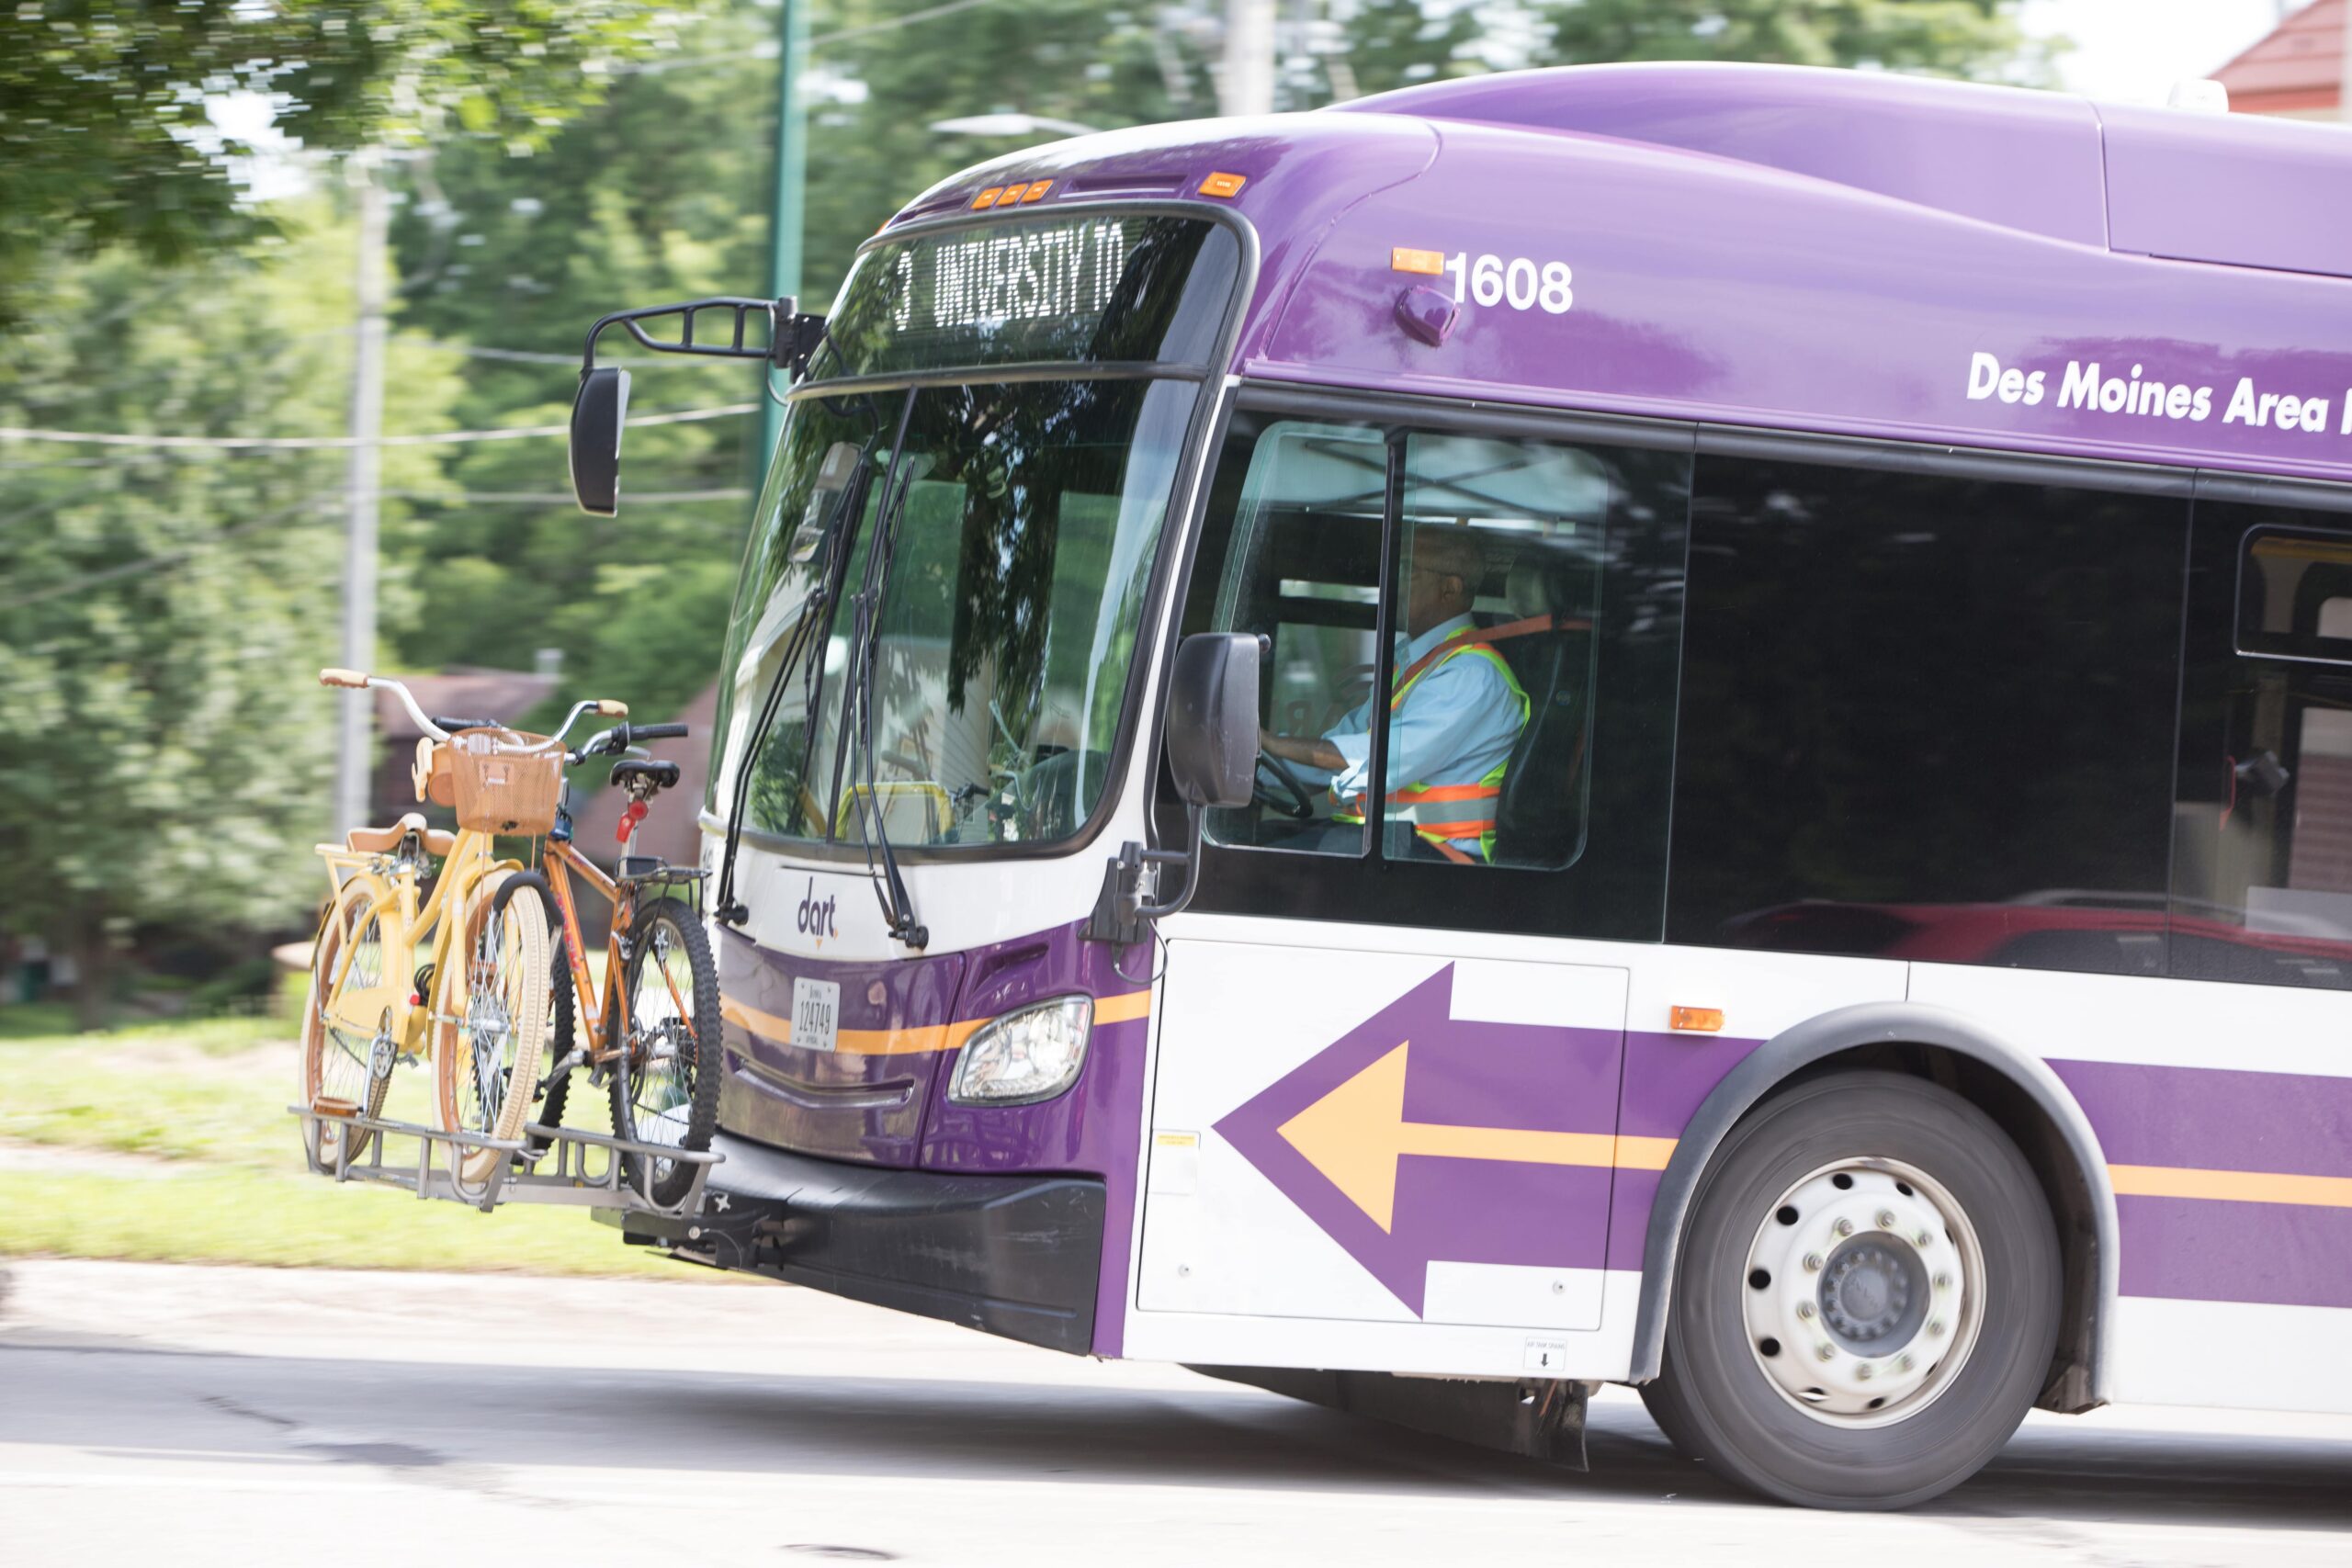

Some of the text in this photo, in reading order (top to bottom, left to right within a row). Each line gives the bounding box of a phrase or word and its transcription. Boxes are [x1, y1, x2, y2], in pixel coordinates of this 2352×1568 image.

[895, 251, 912, 332] 3
[934, 229, 1083, 328] UNIVERSITY
[1445, 252, 1573, 314] 1608
[1967, 352, 2047, 405] Des
[2057, 360, 2213, 422] Moines
[2222, 377, 2330, 433] Area
[797, 876, 836, 938] dart
[799, 1000, 831, 1035] 124749
